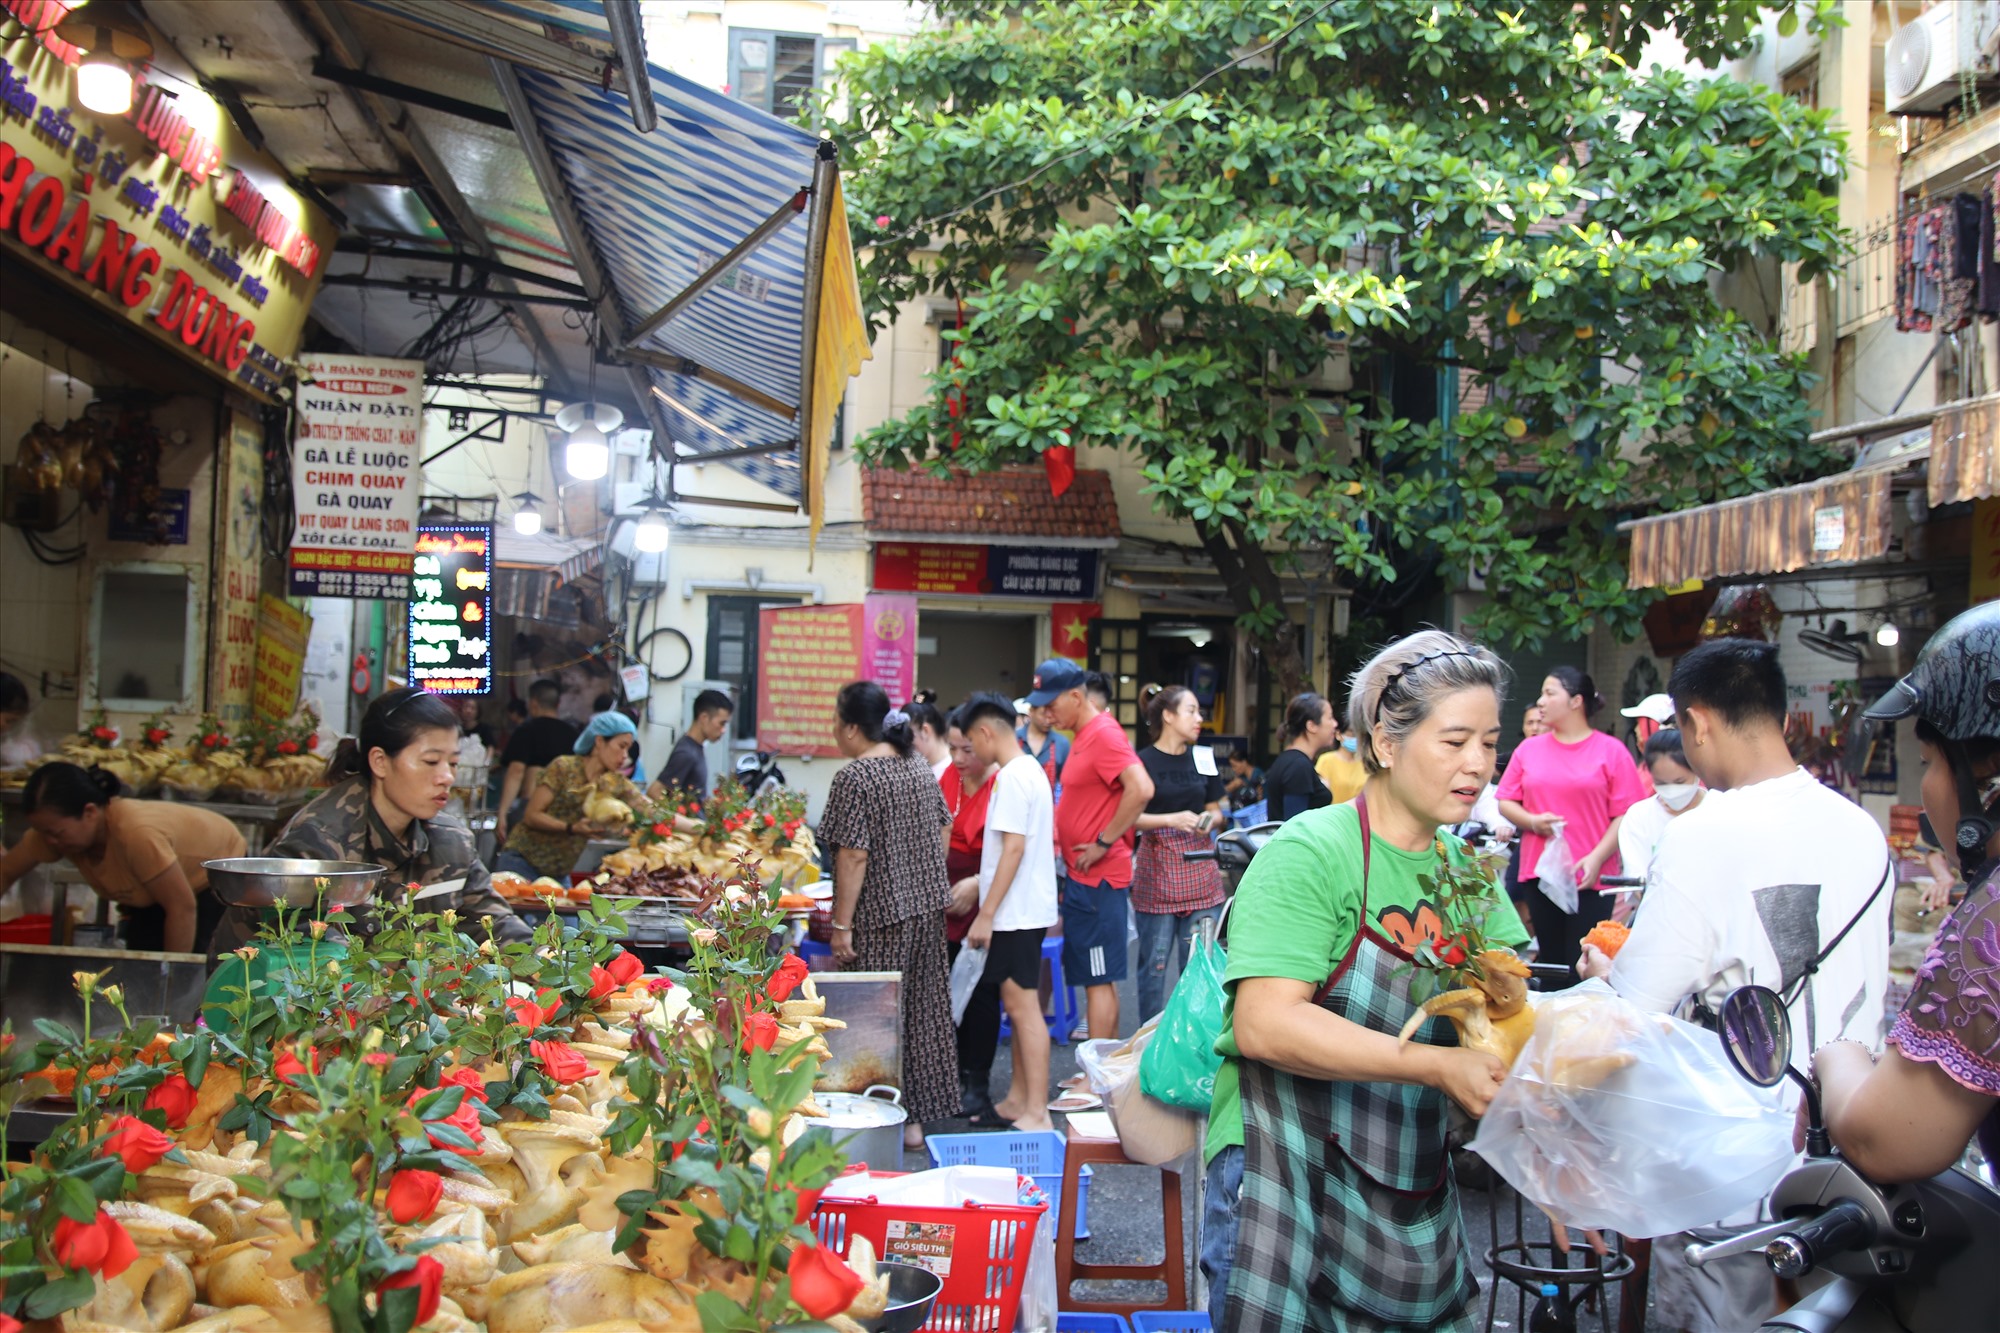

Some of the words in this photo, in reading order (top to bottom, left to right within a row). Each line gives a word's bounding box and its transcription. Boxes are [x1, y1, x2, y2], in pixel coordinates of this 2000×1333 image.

[0, 141, 161, 308] HOÀNG
[155, 268, 256, 371] DUNG
[329, 363, 375, 376] HOÀNG
[305, 399, 362, 415] NHẬN
[369, 401, 415, 418] ĐẶT:
[305, 447, 329, 463] GÀ
[336, 446, 356, 465] LỄ
[363, 451, 409, 471] LUỘC
[306, 470, 354, 487] CHIM
[361, 474, 406, 490] QUAY
[317, 492, 341, 507] GÀ
[348, 495, 393, 510] QUAY
[299, 514, 316, 530] VỊT
[320, 515, 348, 530] QUAY
[351, 517, 382, 534] LẠNG
[386, 518, 410, 533] SƠN
[301, 531, 325, 545] XÔI
[329, 532, 357, 547] CÁC
[893, 1241, 910, 1250] GIỎ
[911, 1243, 930, 1252] SIÊU
[931, 1244, 945, 1254] THỊ
